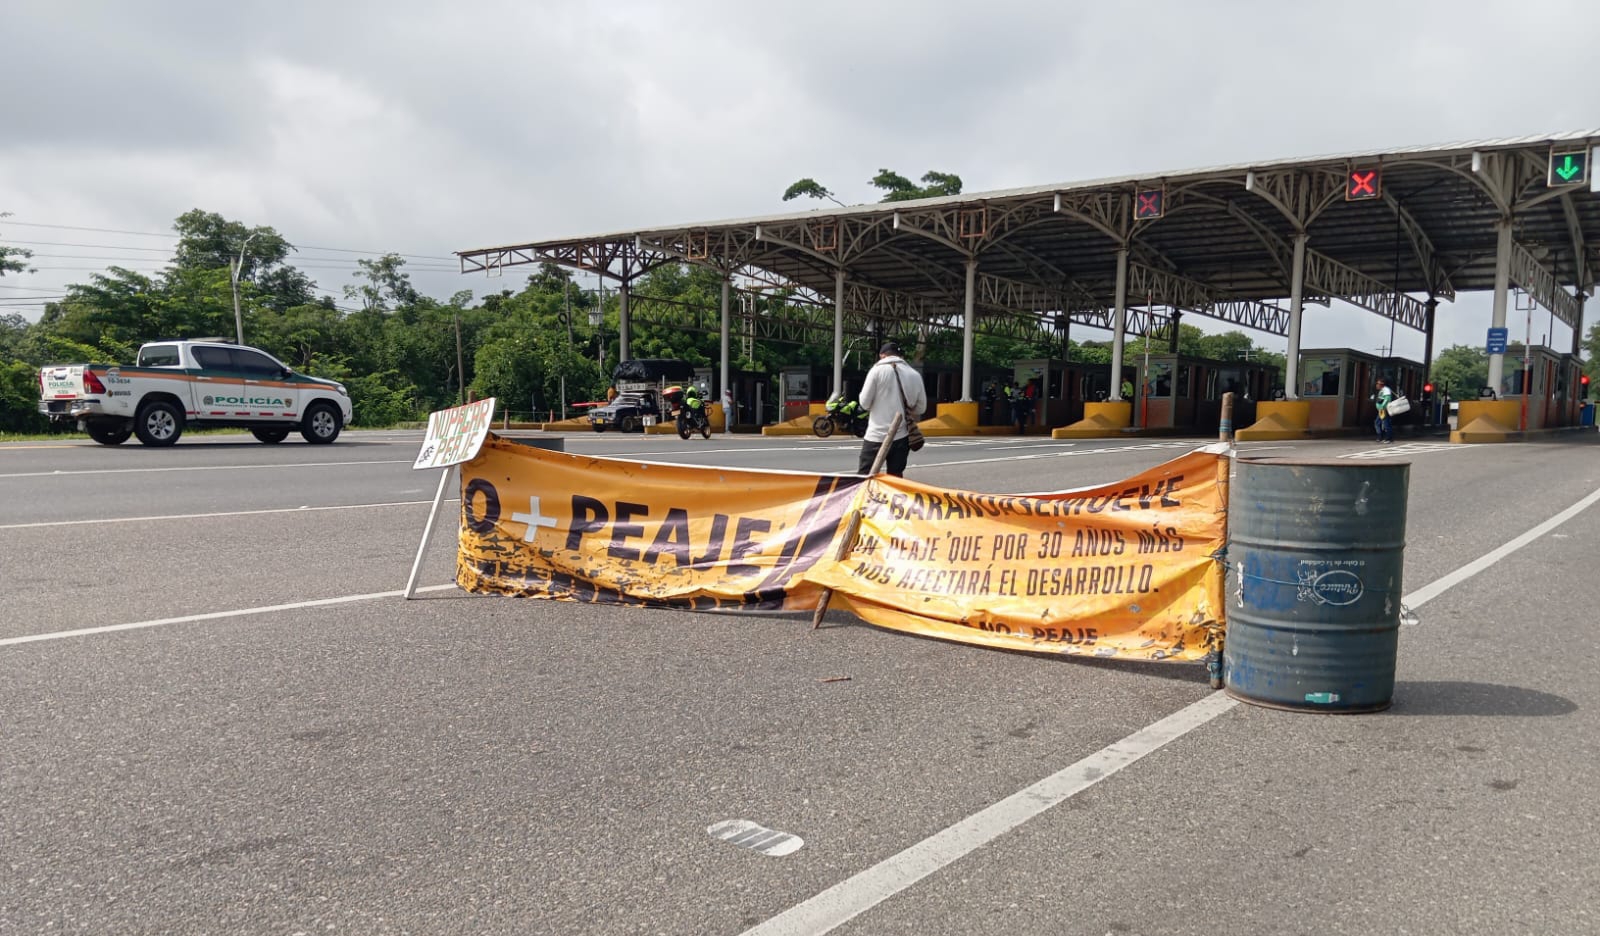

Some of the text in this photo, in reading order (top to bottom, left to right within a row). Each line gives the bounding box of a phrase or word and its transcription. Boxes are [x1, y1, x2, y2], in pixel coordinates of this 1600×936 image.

[565, 494, 771, 575] PEAJE
[886, 536, 941, 562] PEAJE
[947, 535, 983, 564] QUE
[992, 533, 1028, 561] POR
[1038, 530, 1063, 559] 30
[1071, 526, 1126, 558] AÑOS
[1135, 521, 1184, 554] MÁS
[851, 561, 1160, 596] NOS AFECTARÁ EL DESARROLLO.
[1031, 626, 1099, 646] PEAJE
